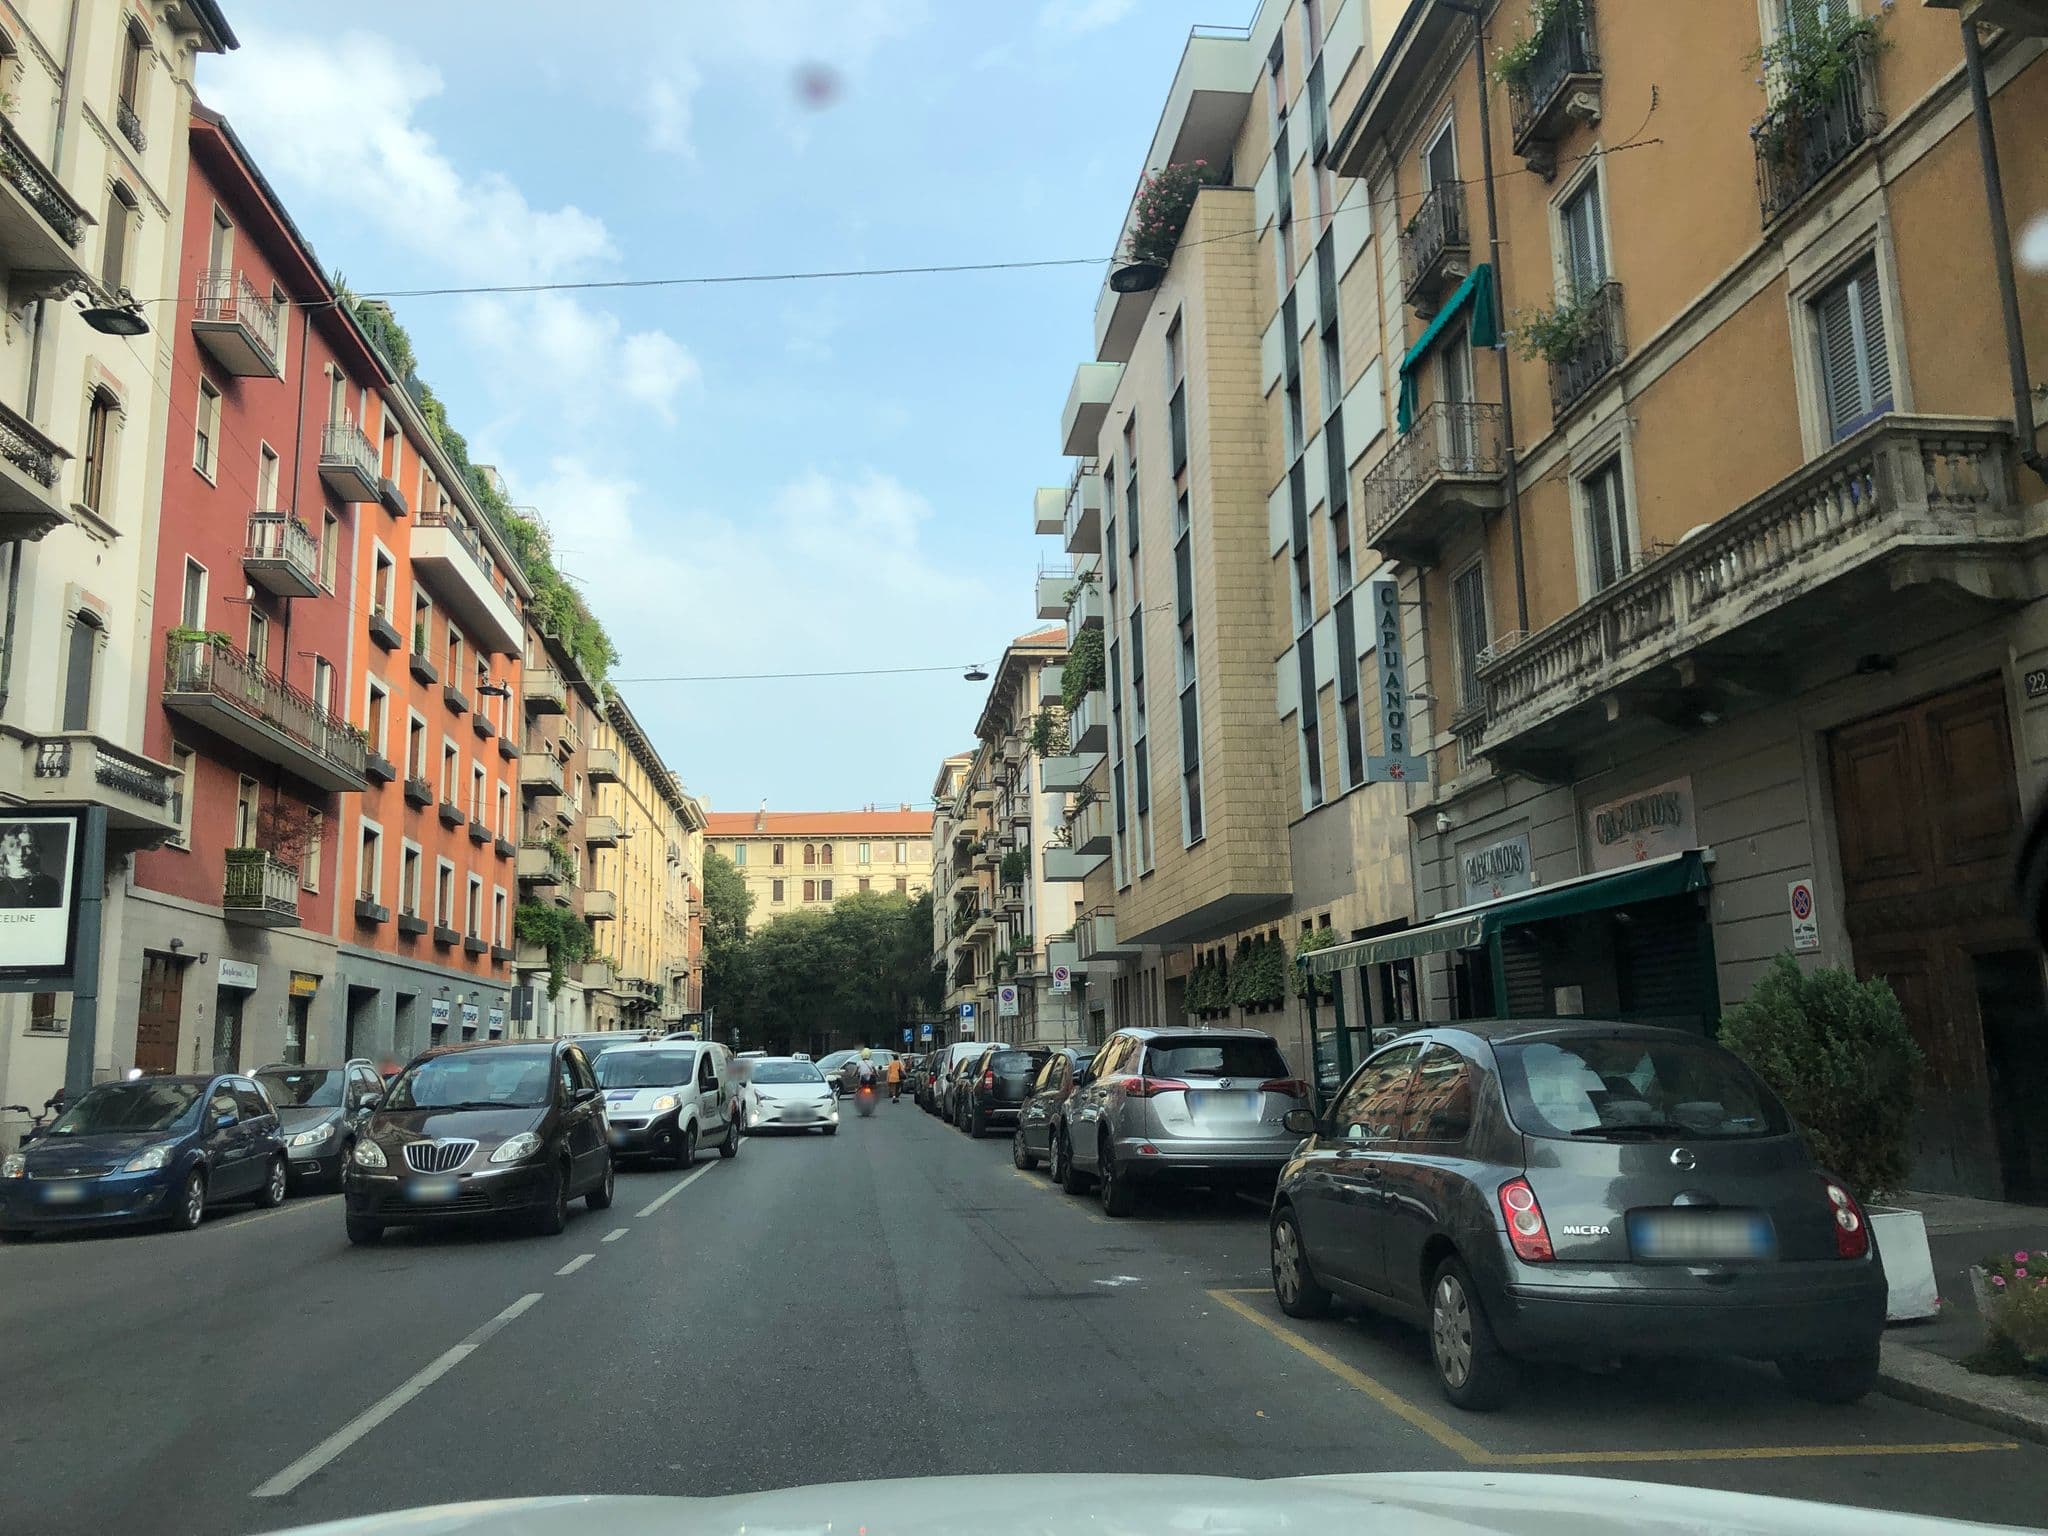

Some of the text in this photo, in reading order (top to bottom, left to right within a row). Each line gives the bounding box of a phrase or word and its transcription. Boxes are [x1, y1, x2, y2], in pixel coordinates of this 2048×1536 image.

[2028, 672, 2048, 692] 22
[963, 1004, 972, 1016] P
[1563, 1225, 1611, 1235] MICRA
